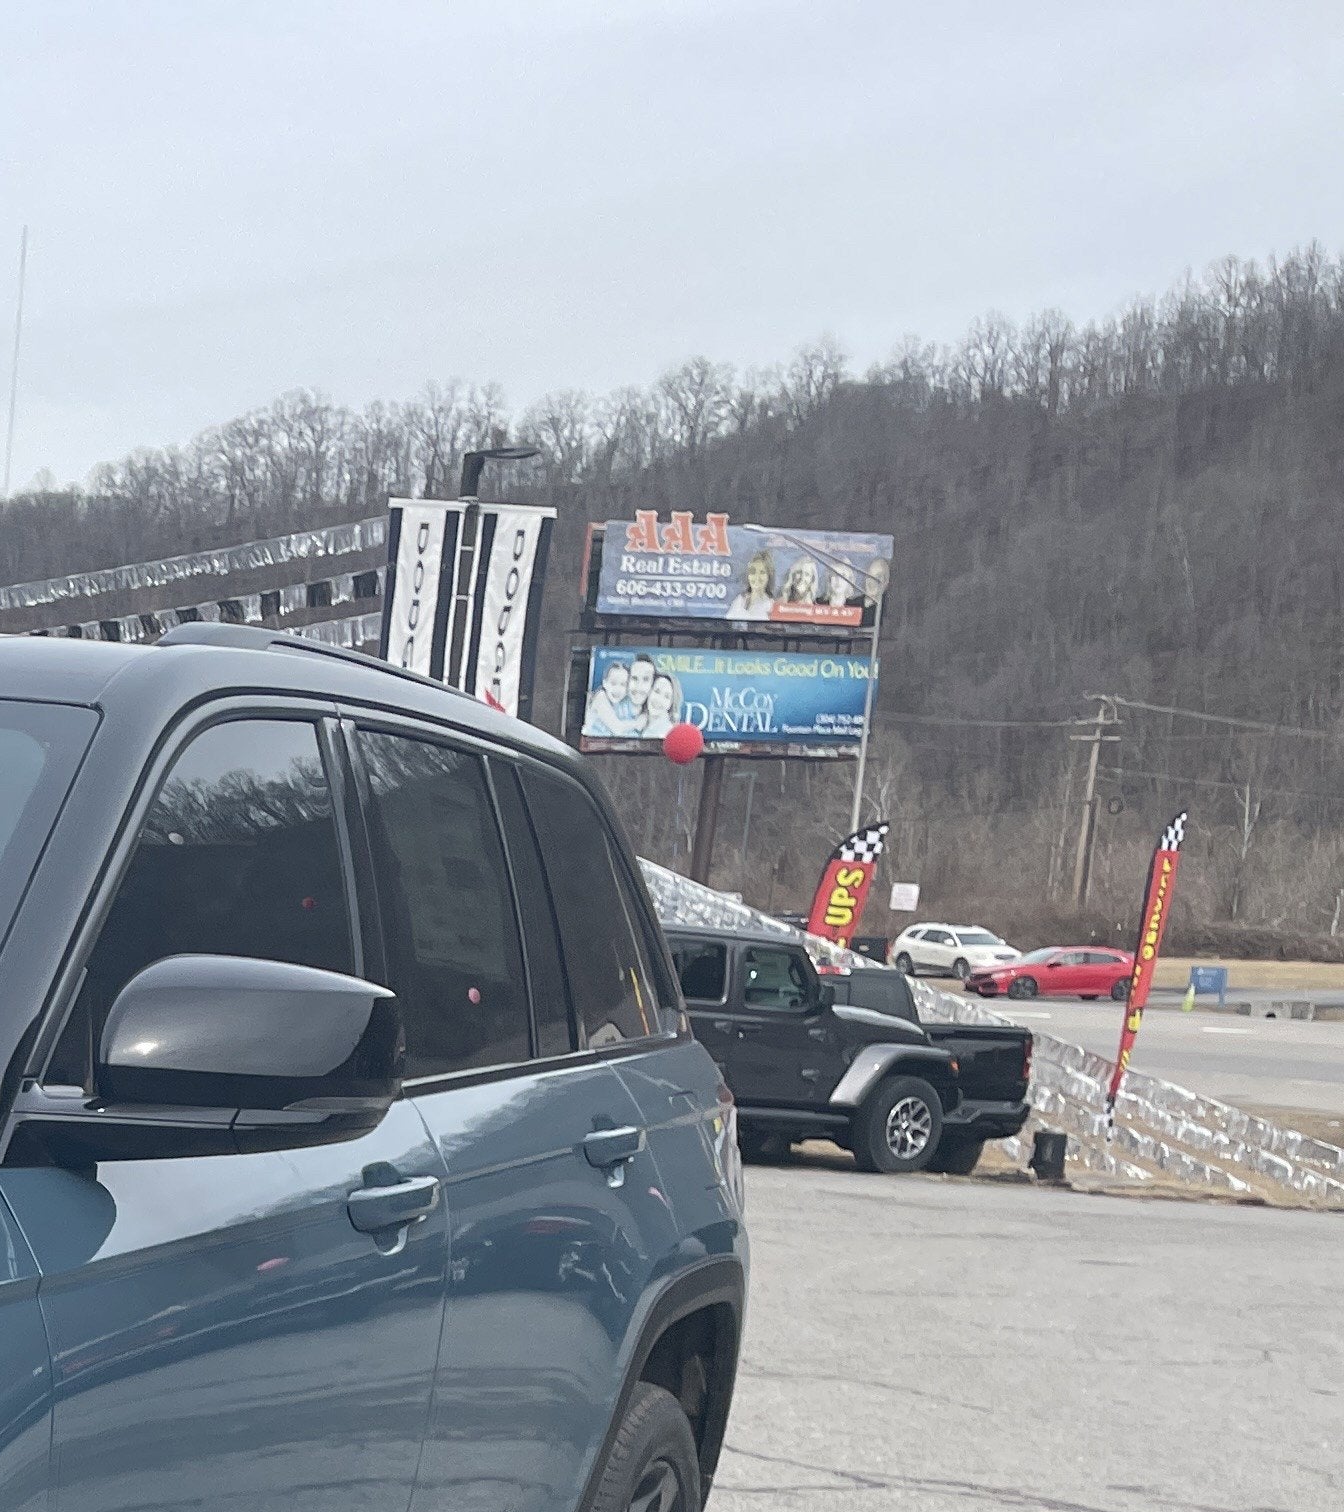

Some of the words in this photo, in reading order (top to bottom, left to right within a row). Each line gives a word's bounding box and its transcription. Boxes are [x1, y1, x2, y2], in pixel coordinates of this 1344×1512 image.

[624, 509, 731, 556] AAA
[619, 554, 664, 573] Real
[667, 556, 732, 577] Estate
[615, 579, 727, 599] 606-433-9700
[727, 657, 771, 676] Looks
[773, 657, 818, 678] Good
[820, 659, 845, 679] On
[685, 701, 778, 733] DENTAL
